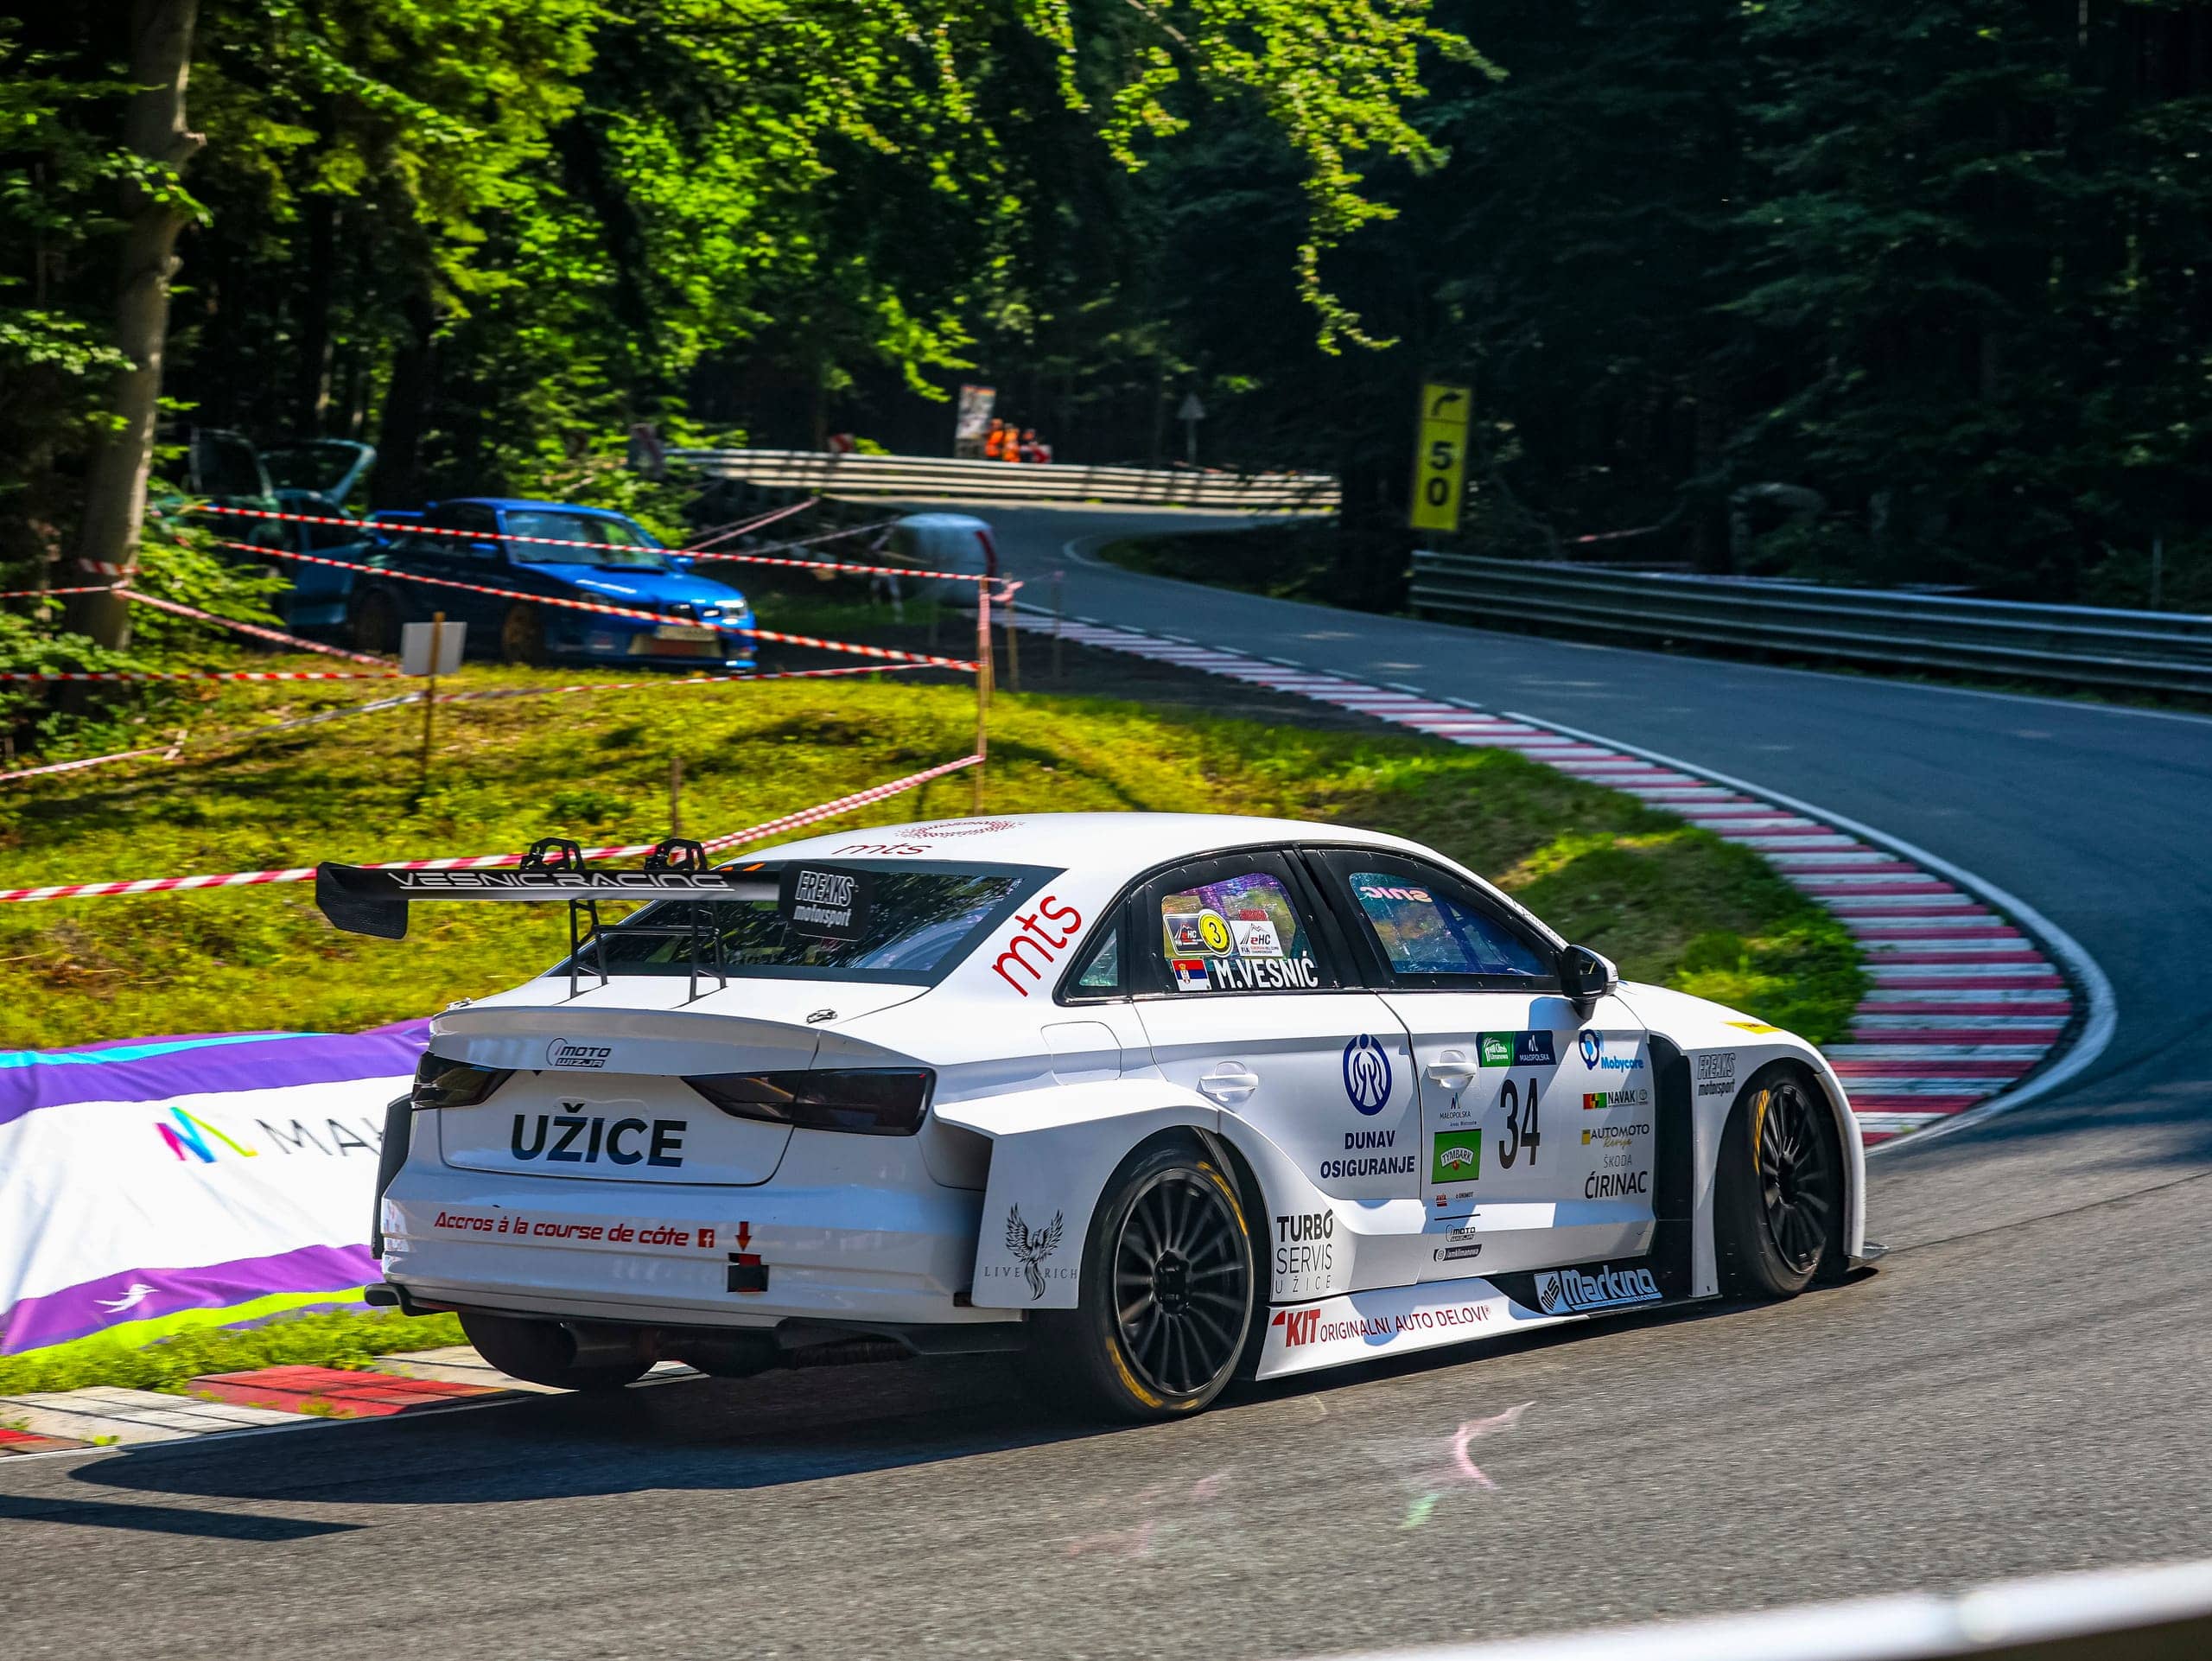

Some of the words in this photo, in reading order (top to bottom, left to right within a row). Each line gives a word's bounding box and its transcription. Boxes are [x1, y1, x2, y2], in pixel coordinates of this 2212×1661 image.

[1427, 440, 1455, 508] 50
[831, 843, 933, 855] mts
[795, 870, 855, 907] FREAKS
[793, 904, 852, 928] motorsport
[1209, 921, 1222, 944] 3
[991, 895, 1082, 997] mts
[556, 1058, 605, 1067] WIZJA
[560, 1046, 612, 1058] MOTO
[1698, 1053, 1736, 1079] FREAKS
[1607, 1090, 1636, 1104] NAVAK
[1698, 1079, 1735, 1097] motorsport
[511, 1103, 688, 1168] UŽICE
[1498, 1079, 1541, 1169] 34
[1591, 1123, 1649, 1139] AUTOMOTO
[1344, 1130, 1395, 1149] DUNAV
[1320, 1155, 1415, 1179] OSIGURANJE
[1441, 1149, 1472, 1164] TYMBARK
[1604, 1155, 1632, 1168] ŠKODA
[1585, 1170, 1648, 1199] ĆIRINAC
[434, 1212, 494, 1231] Accros
[513, 1217, 529, 1234] la
[533, 1223, 603, 1240] course
[607, 1224, 635, 1242] de
[639, 1225, 690, 1246] côte
[1275, 1244, 1332, 1275] SERVIS
[985, 1266, 1020, 1277] LIVE
[1044, 1267, 1078, 1279] RICH
[1274, 1275, 1331, 1294] UŽICE
[1286, 1308, 1320, 1347] KIT
[1320, 1316, 1392, 1342] ORIGINALNI
[1395, 1313, 1433, 1332] AUTO
